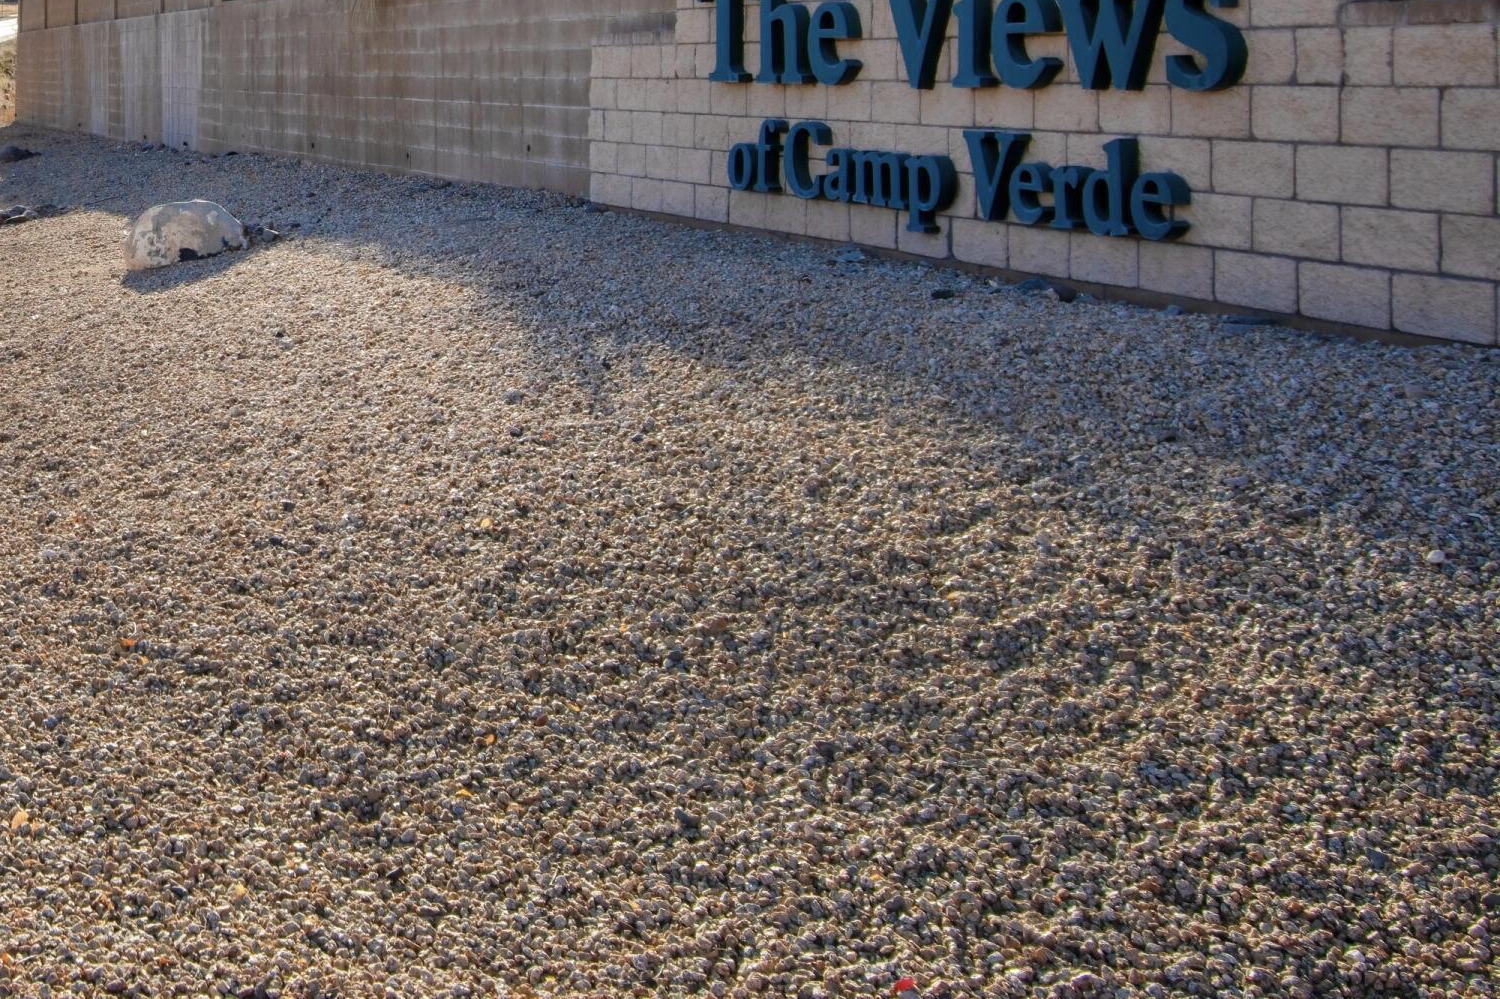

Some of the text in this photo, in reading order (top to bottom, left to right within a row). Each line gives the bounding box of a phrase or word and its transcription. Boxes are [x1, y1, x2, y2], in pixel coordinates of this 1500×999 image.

[727, 119, 1192, 241] of Camp Verde
